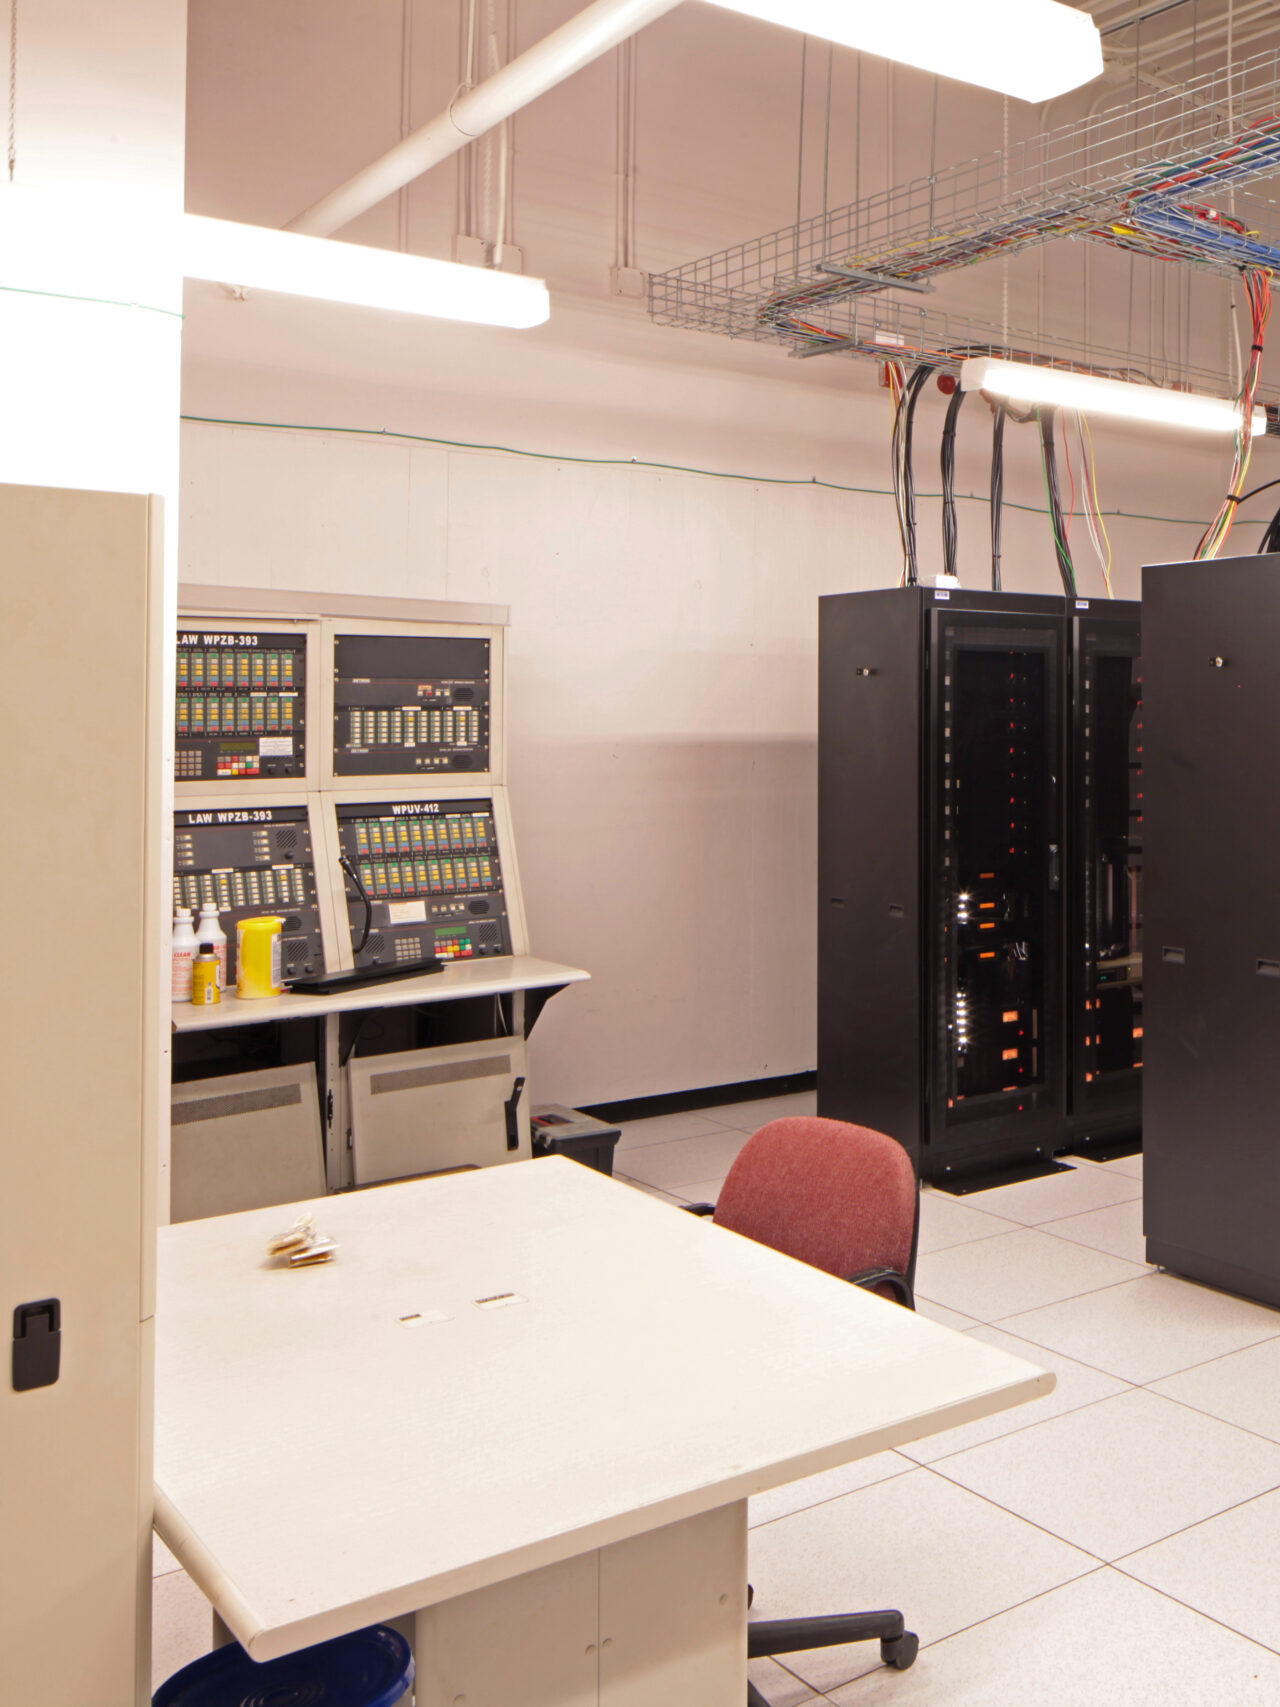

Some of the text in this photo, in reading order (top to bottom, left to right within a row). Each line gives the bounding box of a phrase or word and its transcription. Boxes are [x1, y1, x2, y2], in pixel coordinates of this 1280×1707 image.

[203, 634, 258, 646] WPZB-393
[392, 803, 440, 814] WPUV-412
[188, 810, 273, 825] LAW WPZB-393
